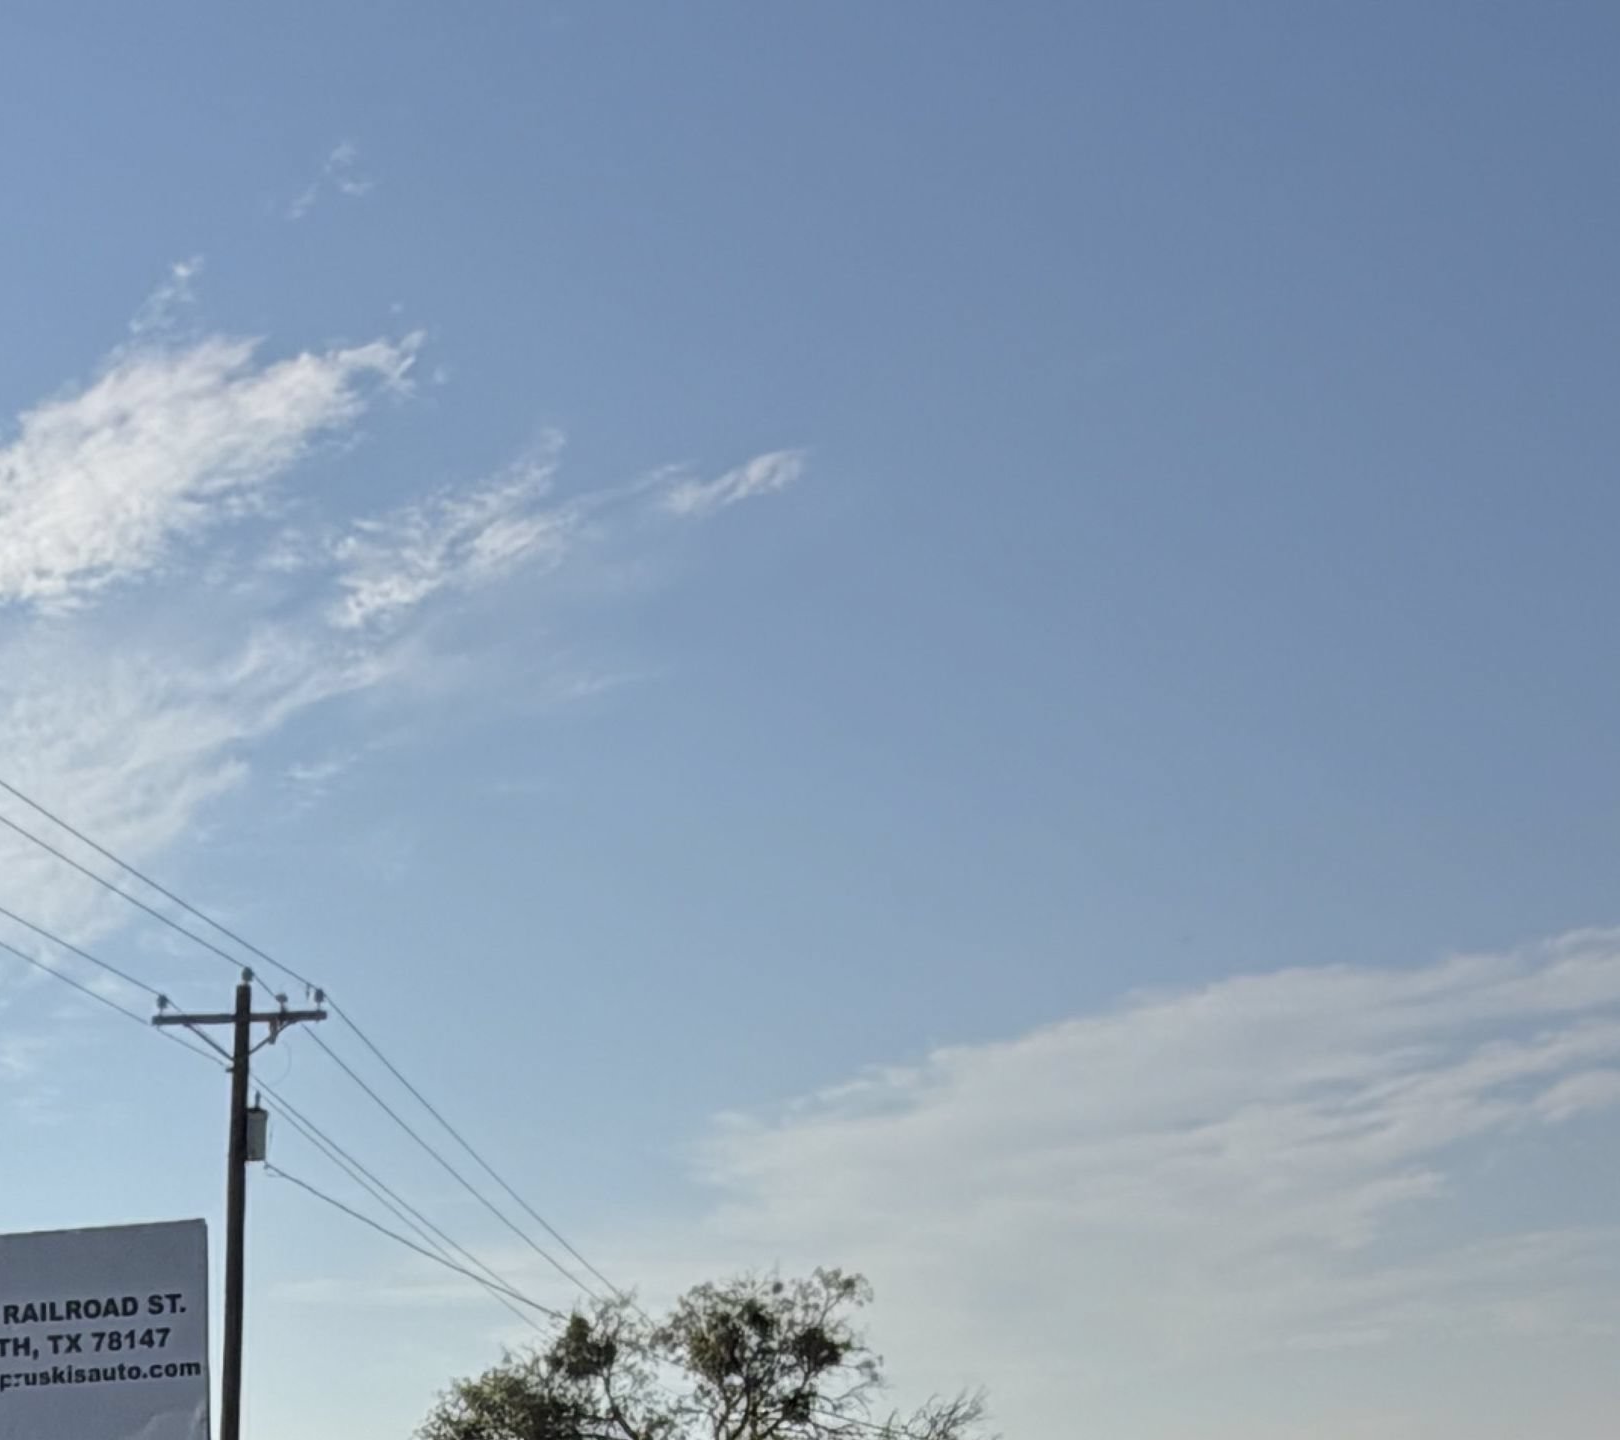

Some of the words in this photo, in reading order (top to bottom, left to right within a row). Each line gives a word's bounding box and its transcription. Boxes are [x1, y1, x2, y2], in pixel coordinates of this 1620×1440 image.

[3, 1296, 138, 1324] RAILROAD
[148, 1293, 186, 1314] ST.
[47, 1333, 82, 1354] TX
[91, 1327, 171, 1352] 78147
